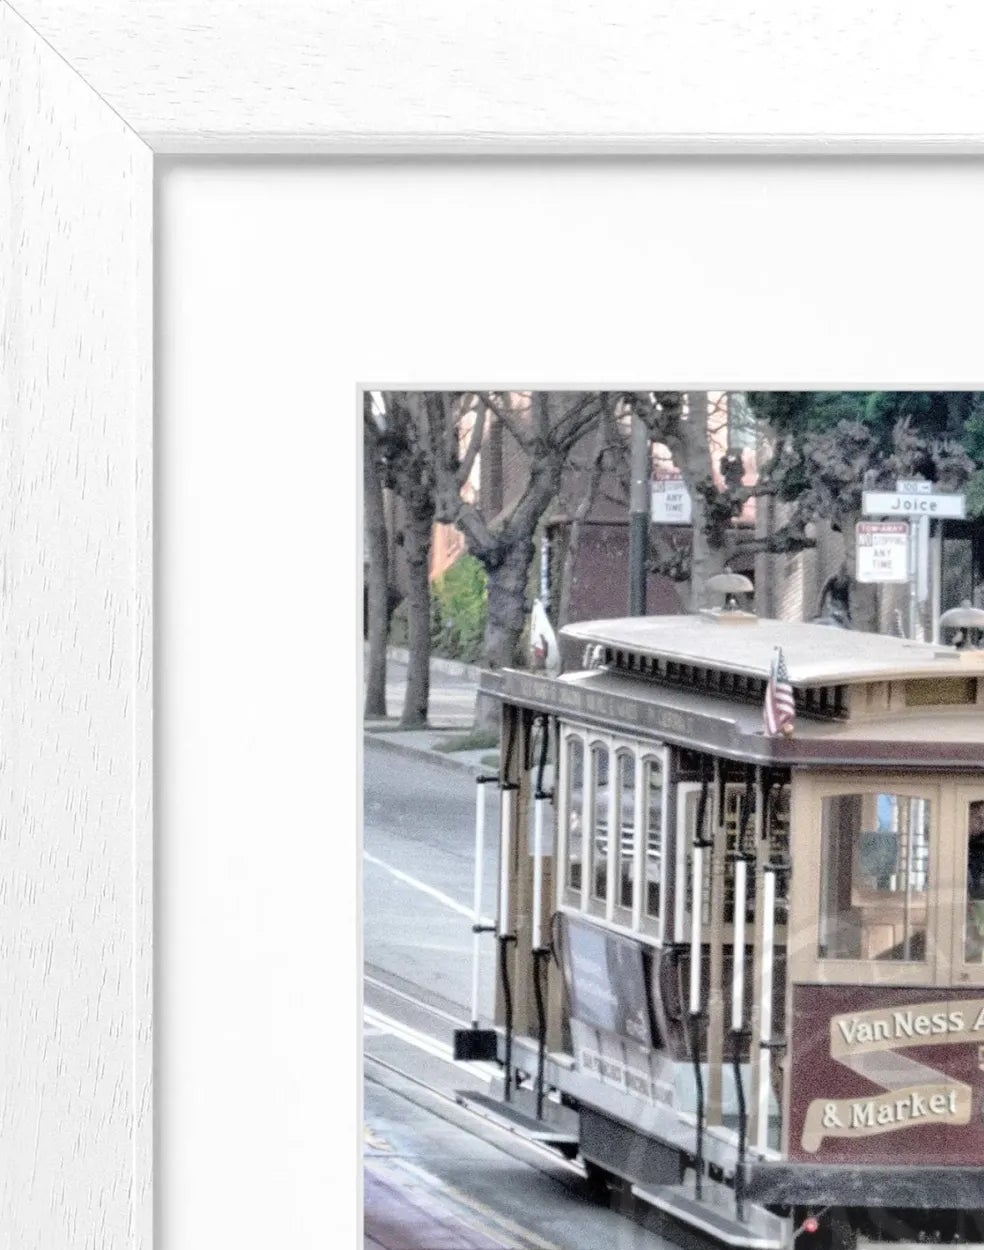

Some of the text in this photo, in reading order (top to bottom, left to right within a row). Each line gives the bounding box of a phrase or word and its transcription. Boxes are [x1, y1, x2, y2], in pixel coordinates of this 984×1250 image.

[665, 503, 683, 511] TIME
[891, 498, 937, 511] Joice
[873, 549, 891, 557] ANY
[872, 560, 892, 569] TIME
[838, 1014, 889, 1044] Van
[893, 1005, 964, 1038] Ness
[822, 1089, 958, 1129] & Market
